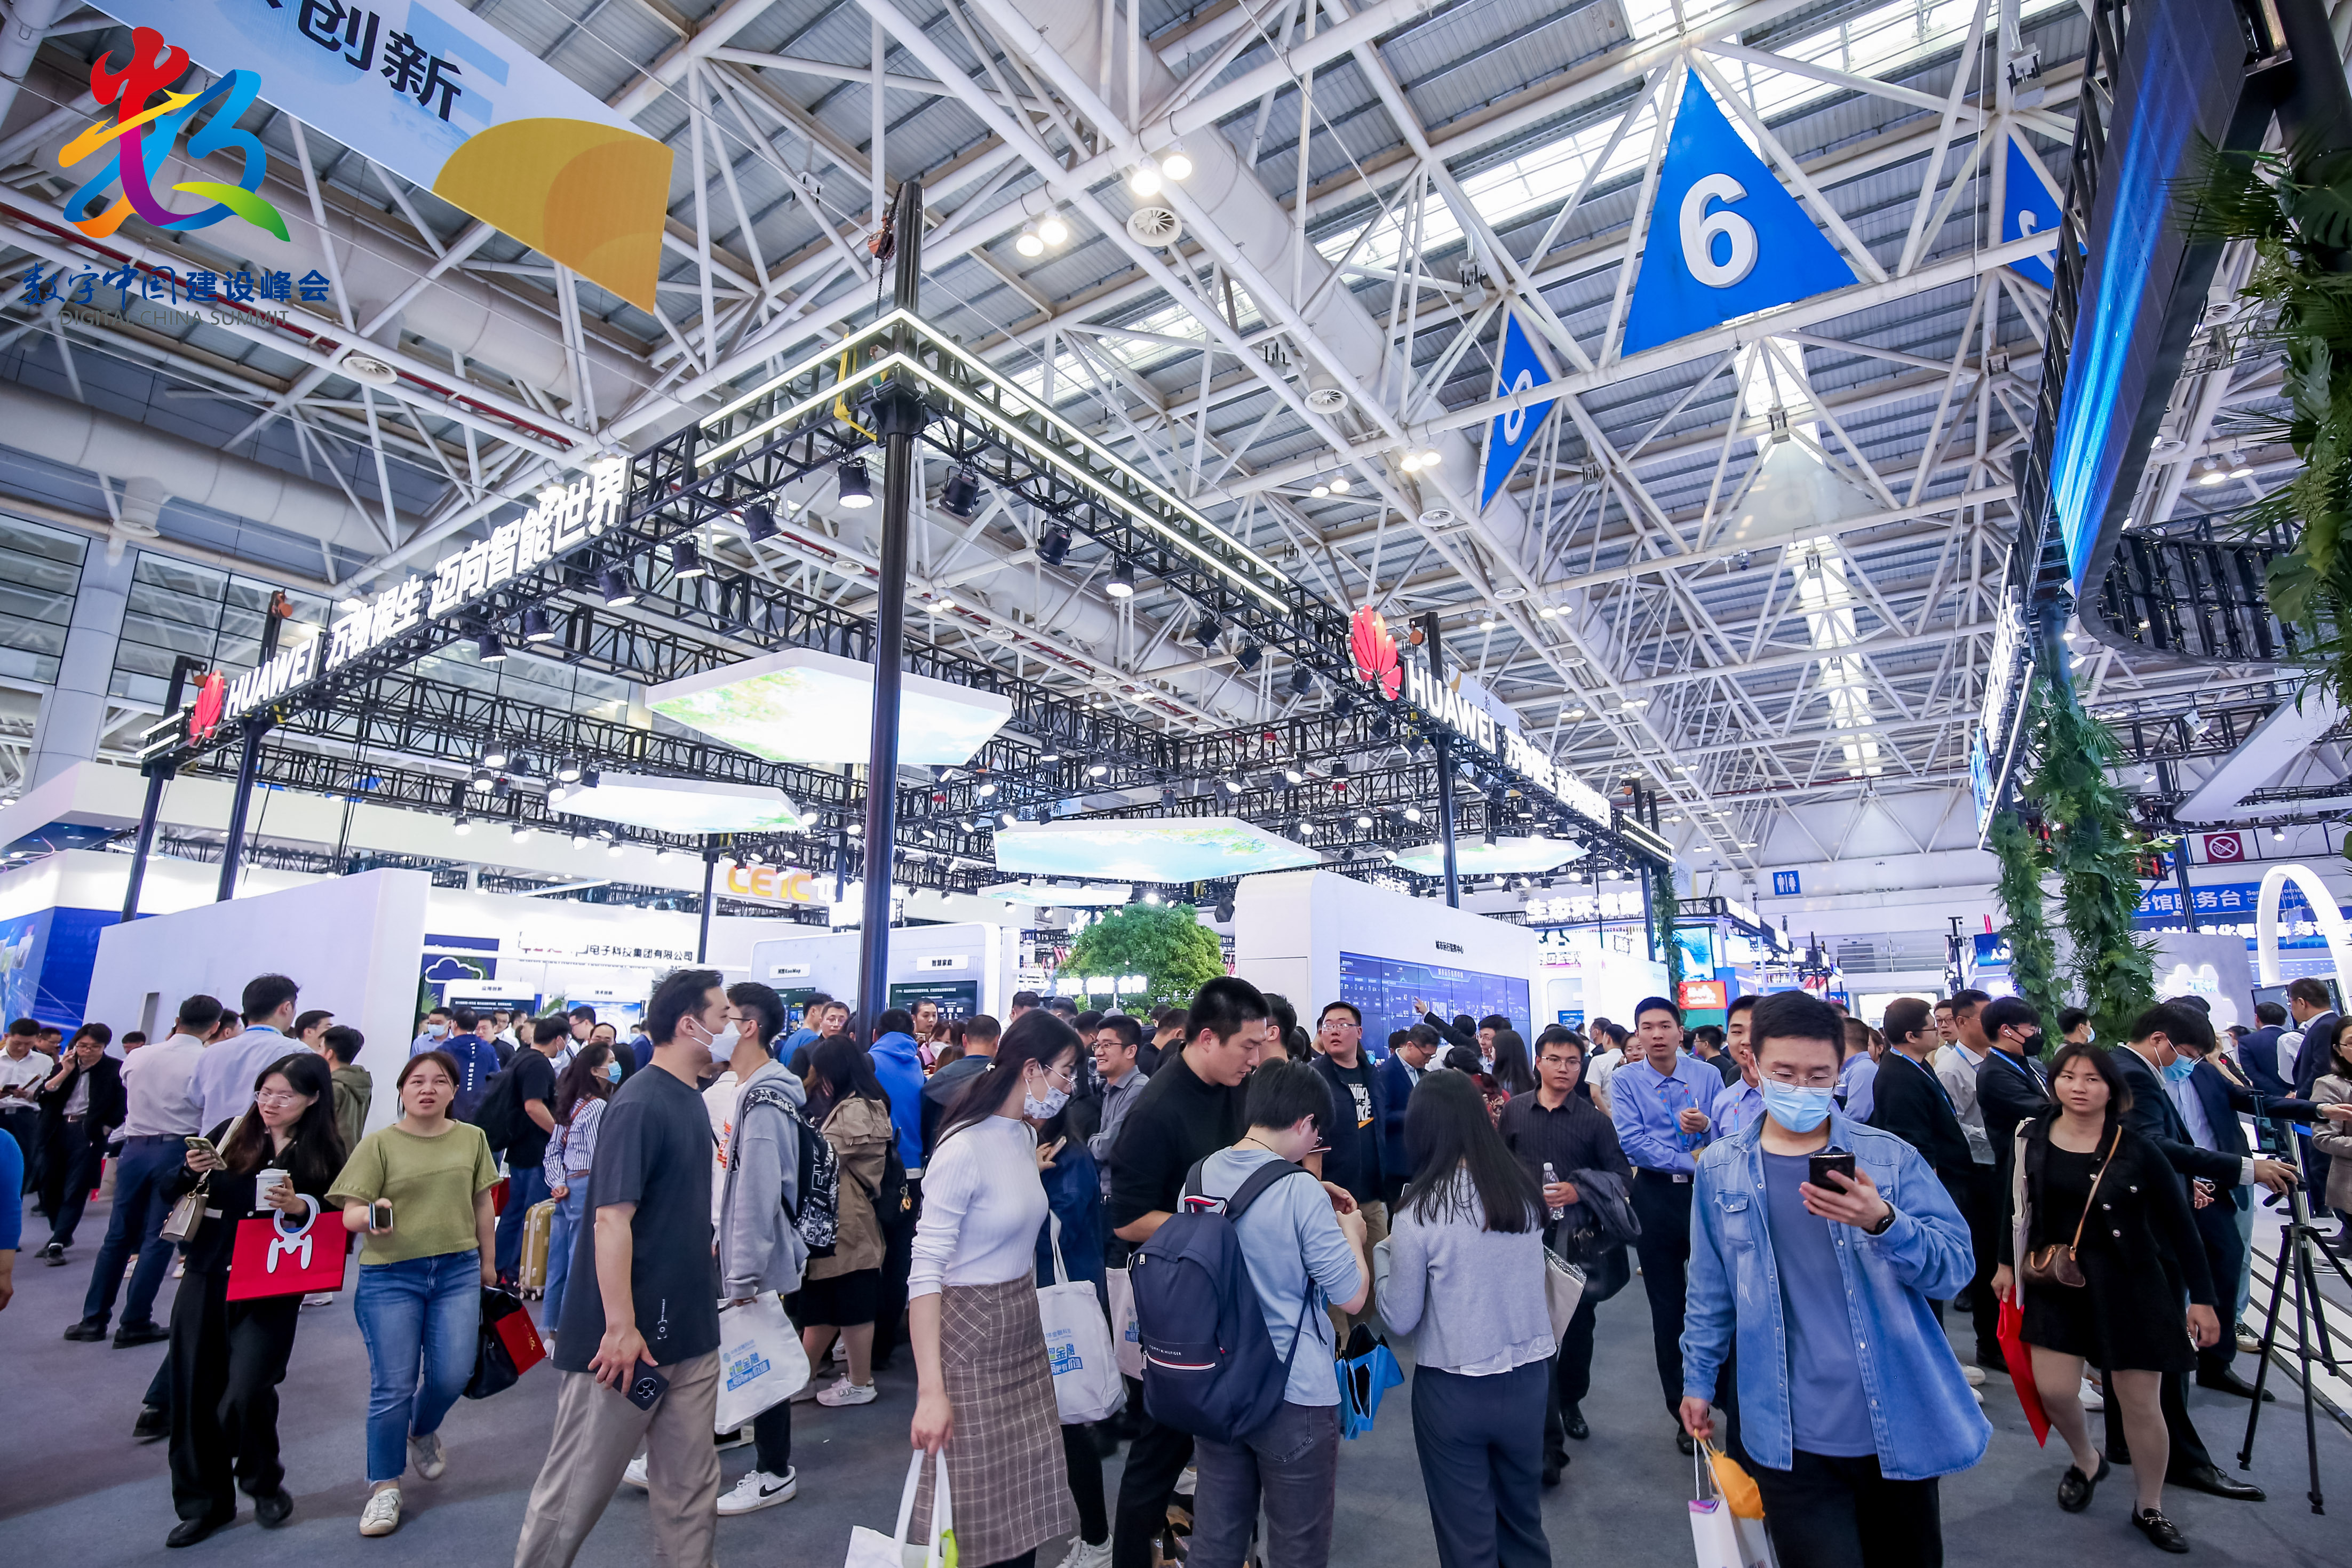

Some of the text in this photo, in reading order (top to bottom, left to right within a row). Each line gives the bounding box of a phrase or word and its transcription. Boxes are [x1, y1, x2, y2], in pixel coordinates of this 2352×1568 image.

[269, 0, 462, 122] 创新
[1679, 173, 1758, 288] 6
[224, 635, 319, 720] HUAWEI
[1406, 659, 1497, 754] HUAWEI
